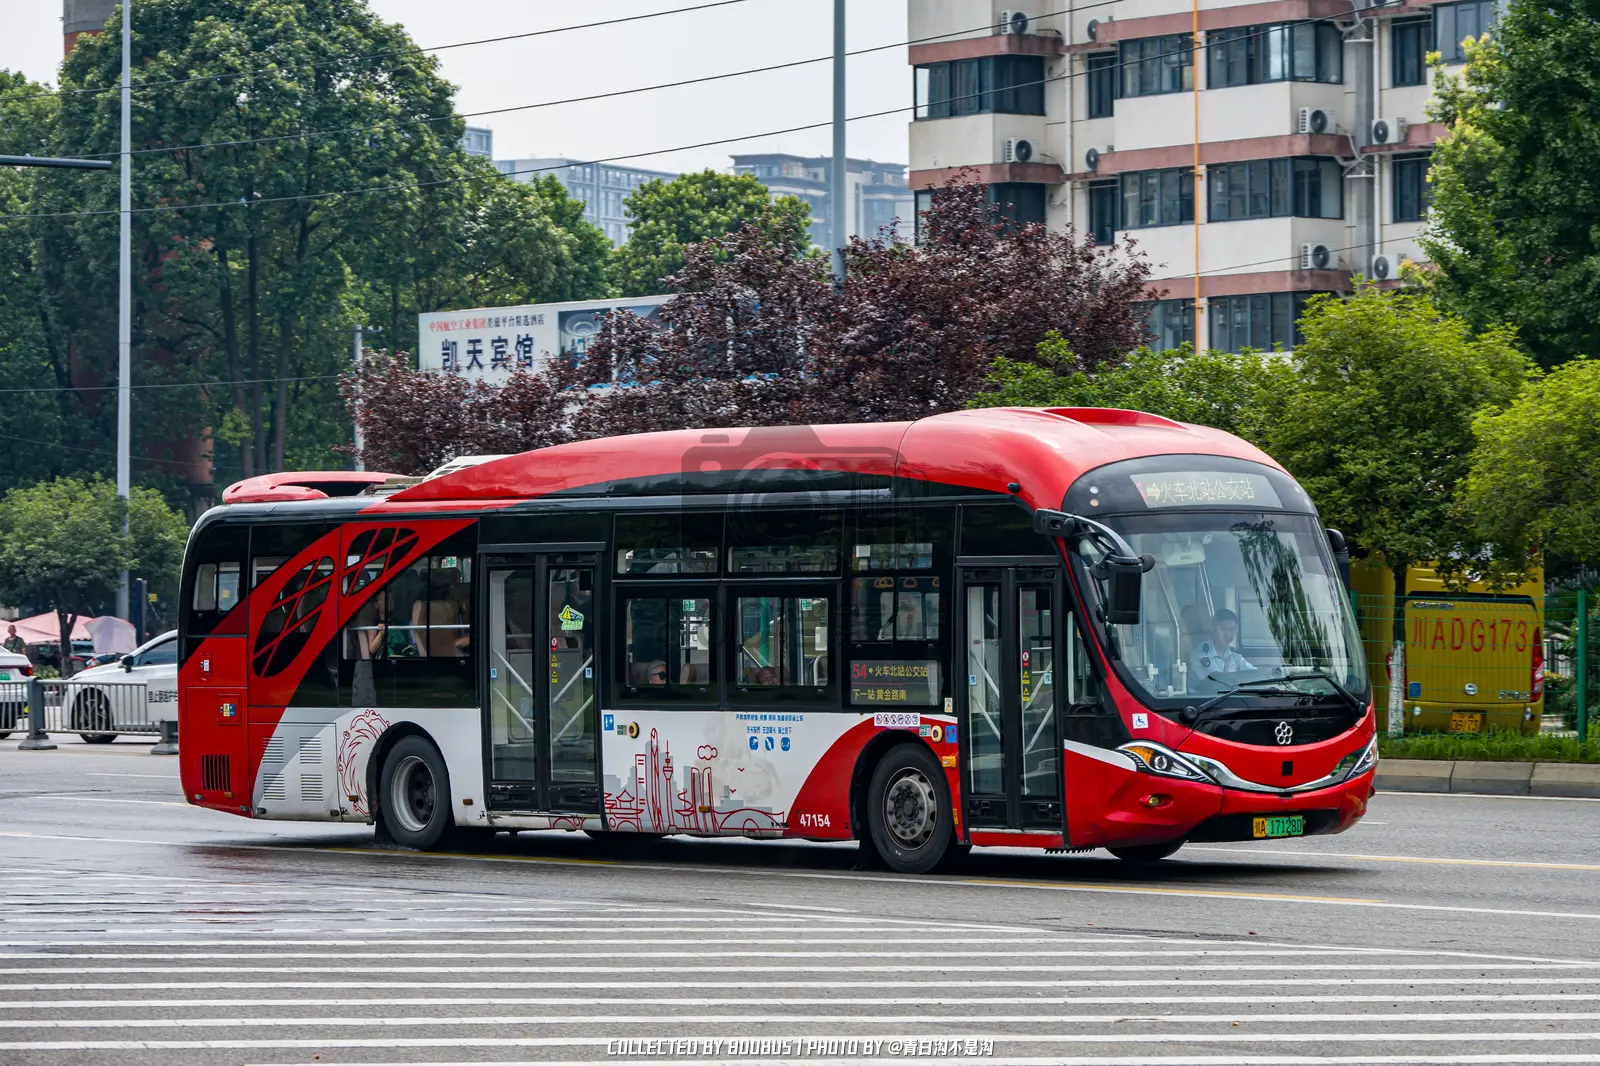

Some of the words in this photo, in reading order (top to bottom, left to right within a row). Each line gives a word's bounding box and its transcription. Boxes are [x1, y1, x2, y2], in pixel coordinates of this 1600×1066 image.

[442, 333, 533, 371] 凯天宾馆
[1160, 475, 1255, 503] 火车北站公交站
[1412, 617, 1528, 652] 川ADG173
[852, 663, 867, 679] 54
[875, 665, 928, 677] 火车北站公交站
[800, 814, 831, 828] 47154
